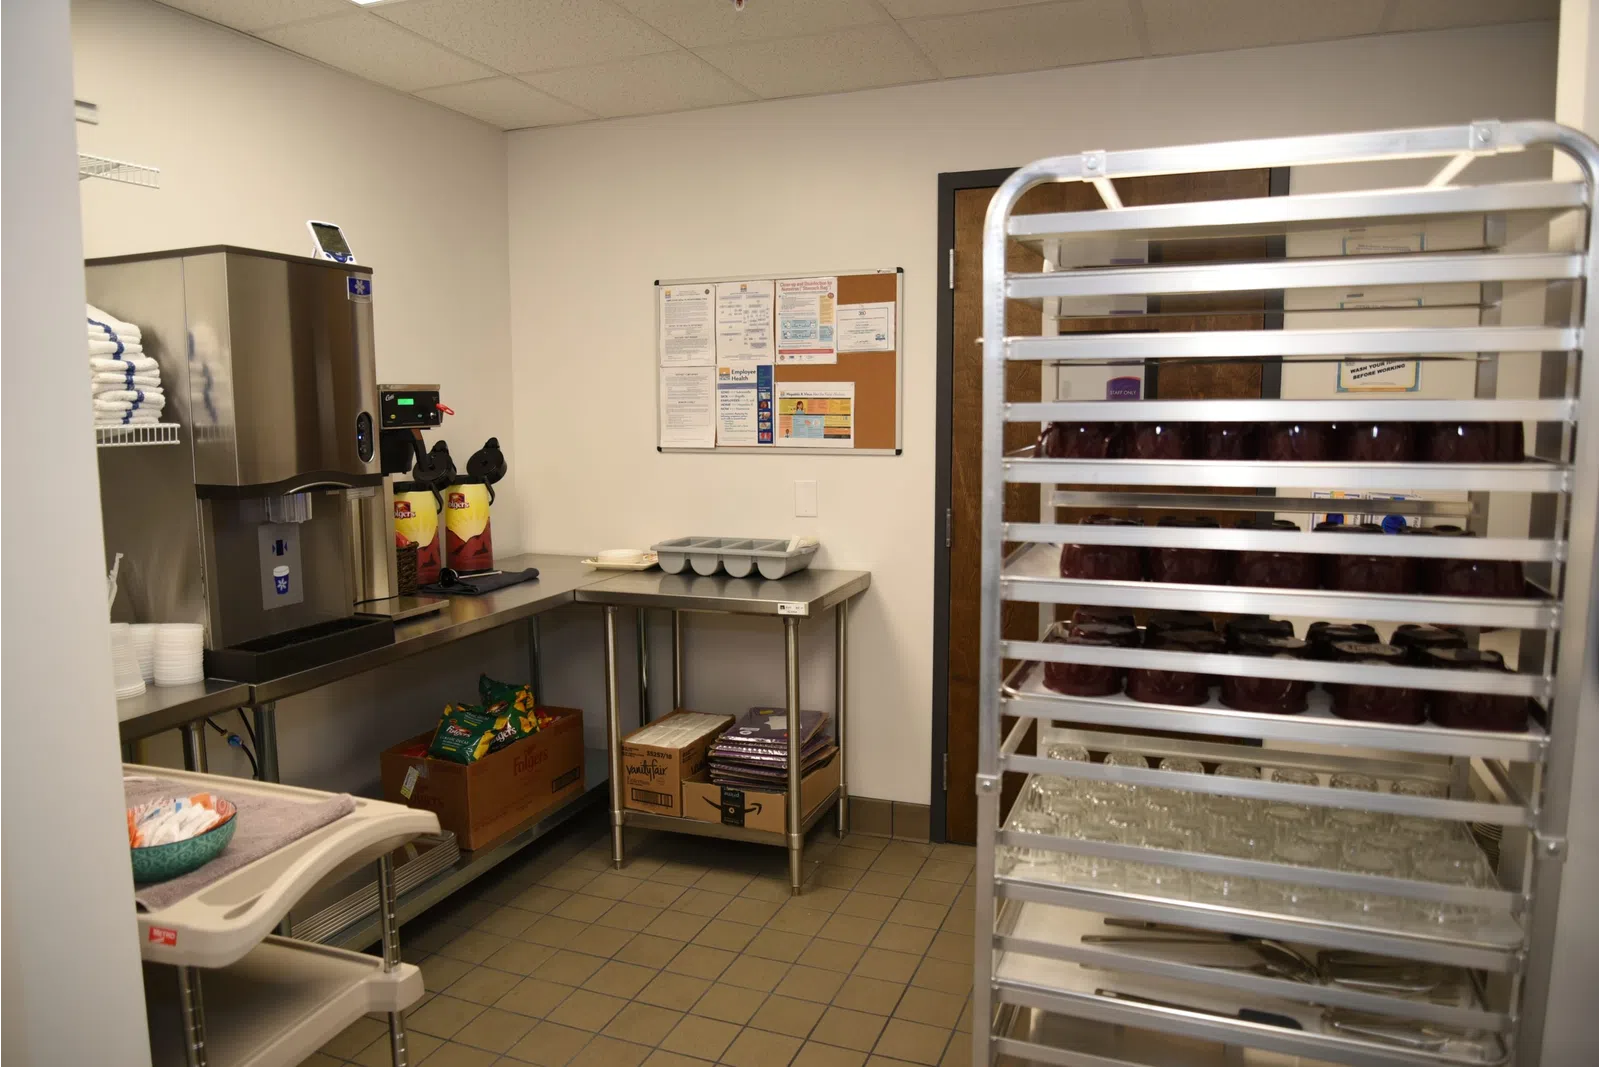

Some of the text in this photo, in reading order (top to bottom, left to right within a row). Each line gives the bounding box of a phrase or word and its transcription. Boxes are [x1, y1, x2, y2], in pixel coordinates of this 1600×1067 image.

[1350, 365, 1368, 374] WASH
[1369, 361, 1385, 369] YOUR
[1353, 371, 1376, 380] BEFORE
[1377, 363, 1406, 374] WORKING
[448, 501, 470, 510] olgers
[393, 510, 416, 519] olgers
[446, 725, 473, 738] Folgers
[513, 748, 549, 777] Folgers
